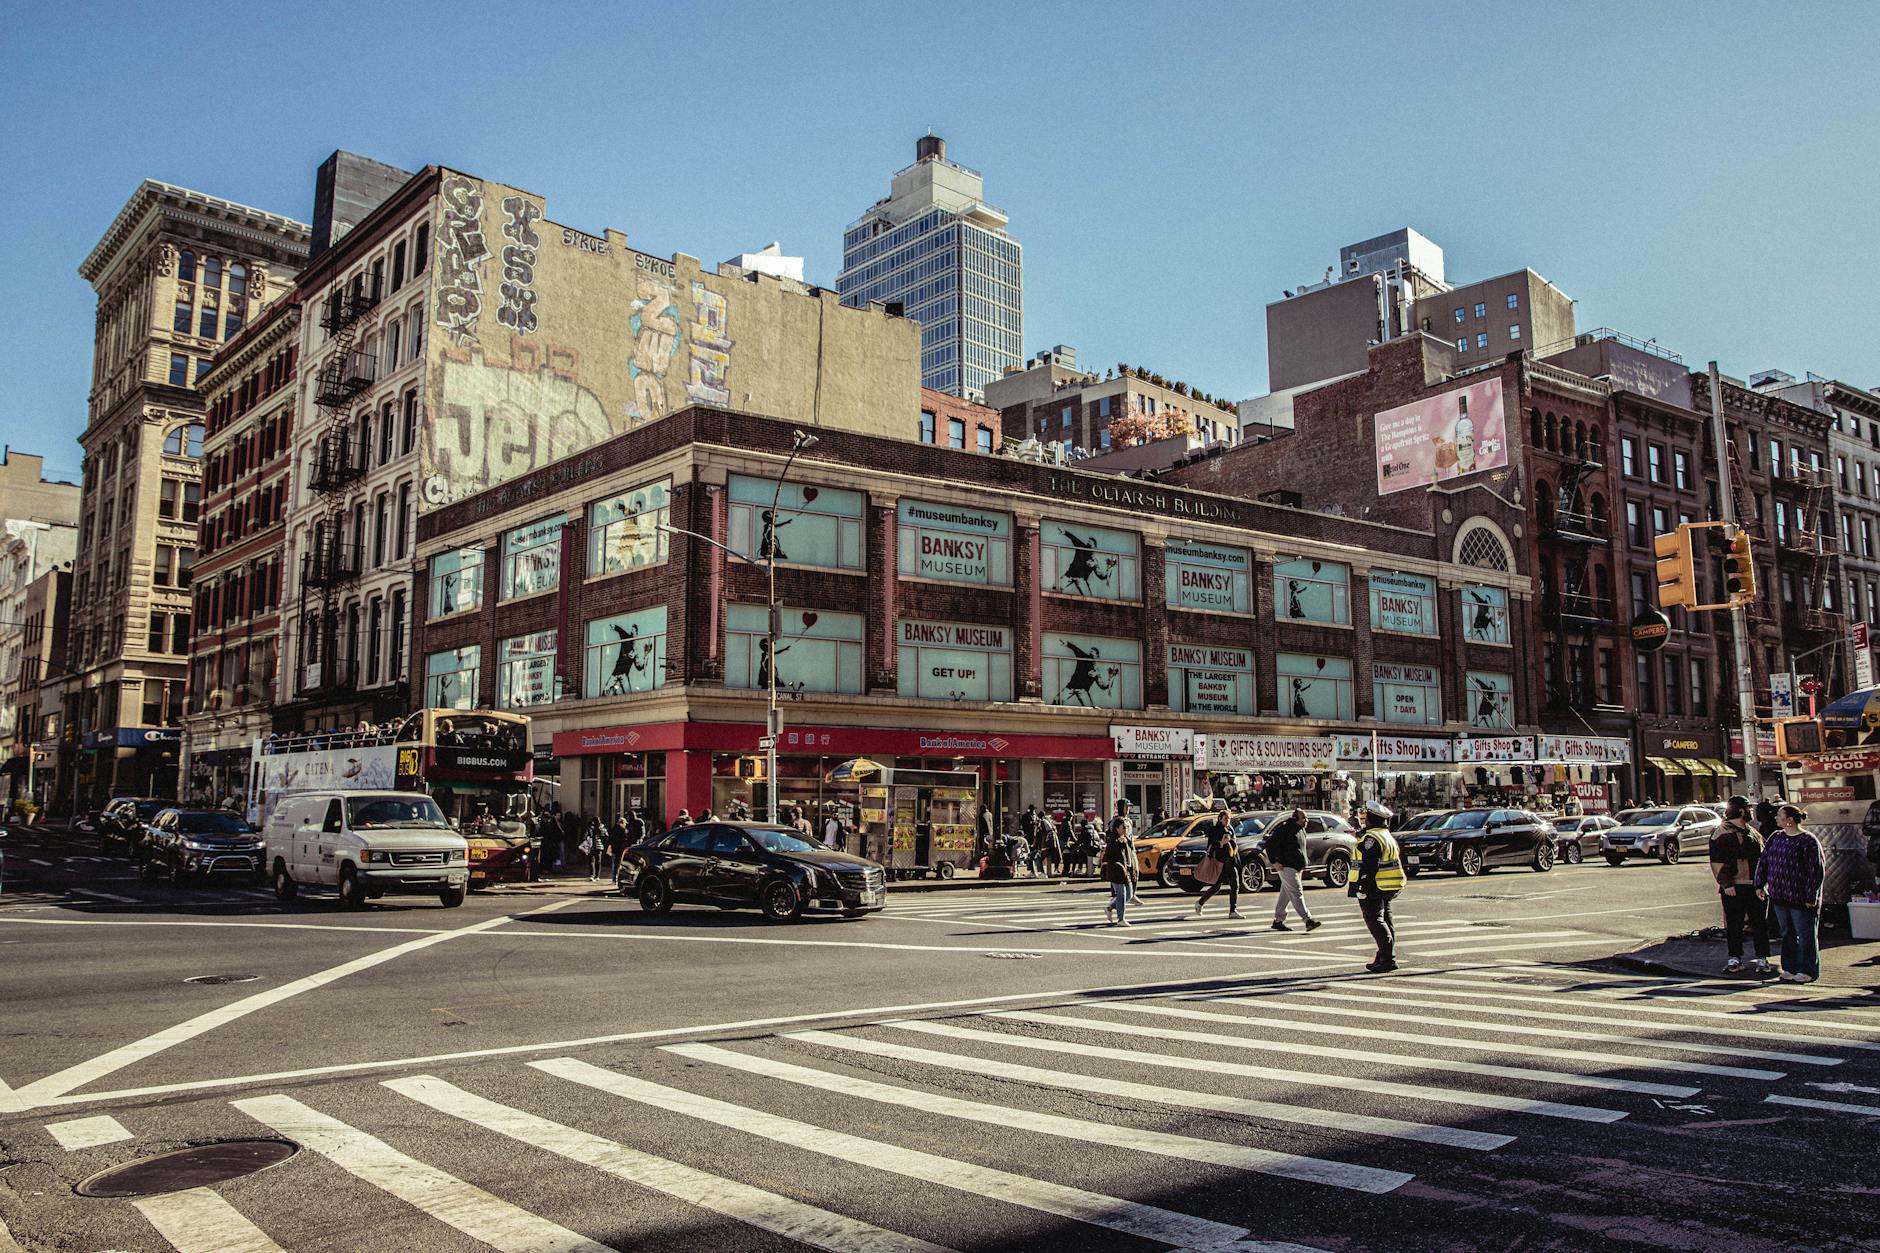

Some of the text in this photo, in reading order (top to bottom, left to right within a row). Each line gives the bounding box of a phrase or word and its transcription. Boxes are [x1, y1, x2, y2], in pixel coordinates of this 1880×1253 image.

[1048, 476, 1241, 521] THE OLTARSH BUILDING
[907, 506, 999, 531] #museumbanksy
[921, 536, 985, 561] BANKSY
[921, 559, 987, 577] MUSEUM
[1181, 570, 1230, 591] BANKSY
[1181, 591, 1232, 605] MUSEUM
[1381, 596, 1419, 616] BANKSY
[1382, 615, 1421, 627] MUSEUM
[904, 623, 1003, 648] BANKSY MUSEUM
[1633, 626, 1665, 637] CAMPERO
[1171, 647, 1246, 667] BANKSY MUSEUM
[932, 667, 976, 679] GET UP!
[1189, 671, 1236, 681] THE LARGEST
[1374, 664, 1432, 683] BANKSY MUSEUM
[1198, 682, 1227, 690] BANKSY
[776, 692, 804, 701] CANAL ST
[1197, 692, 1228, 701] MUSEUM
[1395, 695, 1414, 703] OPEN
[1198, 703, 1211, 711] THE
[1213, 703, 1238, 712] WORLD
[1399, 706, 1416, 714] DAYS
[1135, 729, 1171, 742] BANKSY
[920, 736, 987, 749] Bank of America
[1135, 742, 1172, 751] MUSEUM
[1396, 739, 1420, 758] Shop
[1474, 739, 1491, 751] Gifts
[1493, 739, 1511, 752] Shop
[1672, 740, 1698, 749] CAMPERO
[1230, 740, 1333, 758] GIFTS & SOUVENIRS SHOP
[1565, 740, 1603, 760] Gifts Shop
[400, 750, 411, 763] BIG
[457, 756, 507, 767] BIGBUS.COM
[1819, 752, 1868, 763] HALAL
[399, 763, 411, 775] BUS
[1268, 760, 1305, 768] ACCESSORIES
[1823, 761, 1864, 771] FOOD
[1577, 785, 1603, 797] GUYS
[1802, 791, 1824, 799] Halal
